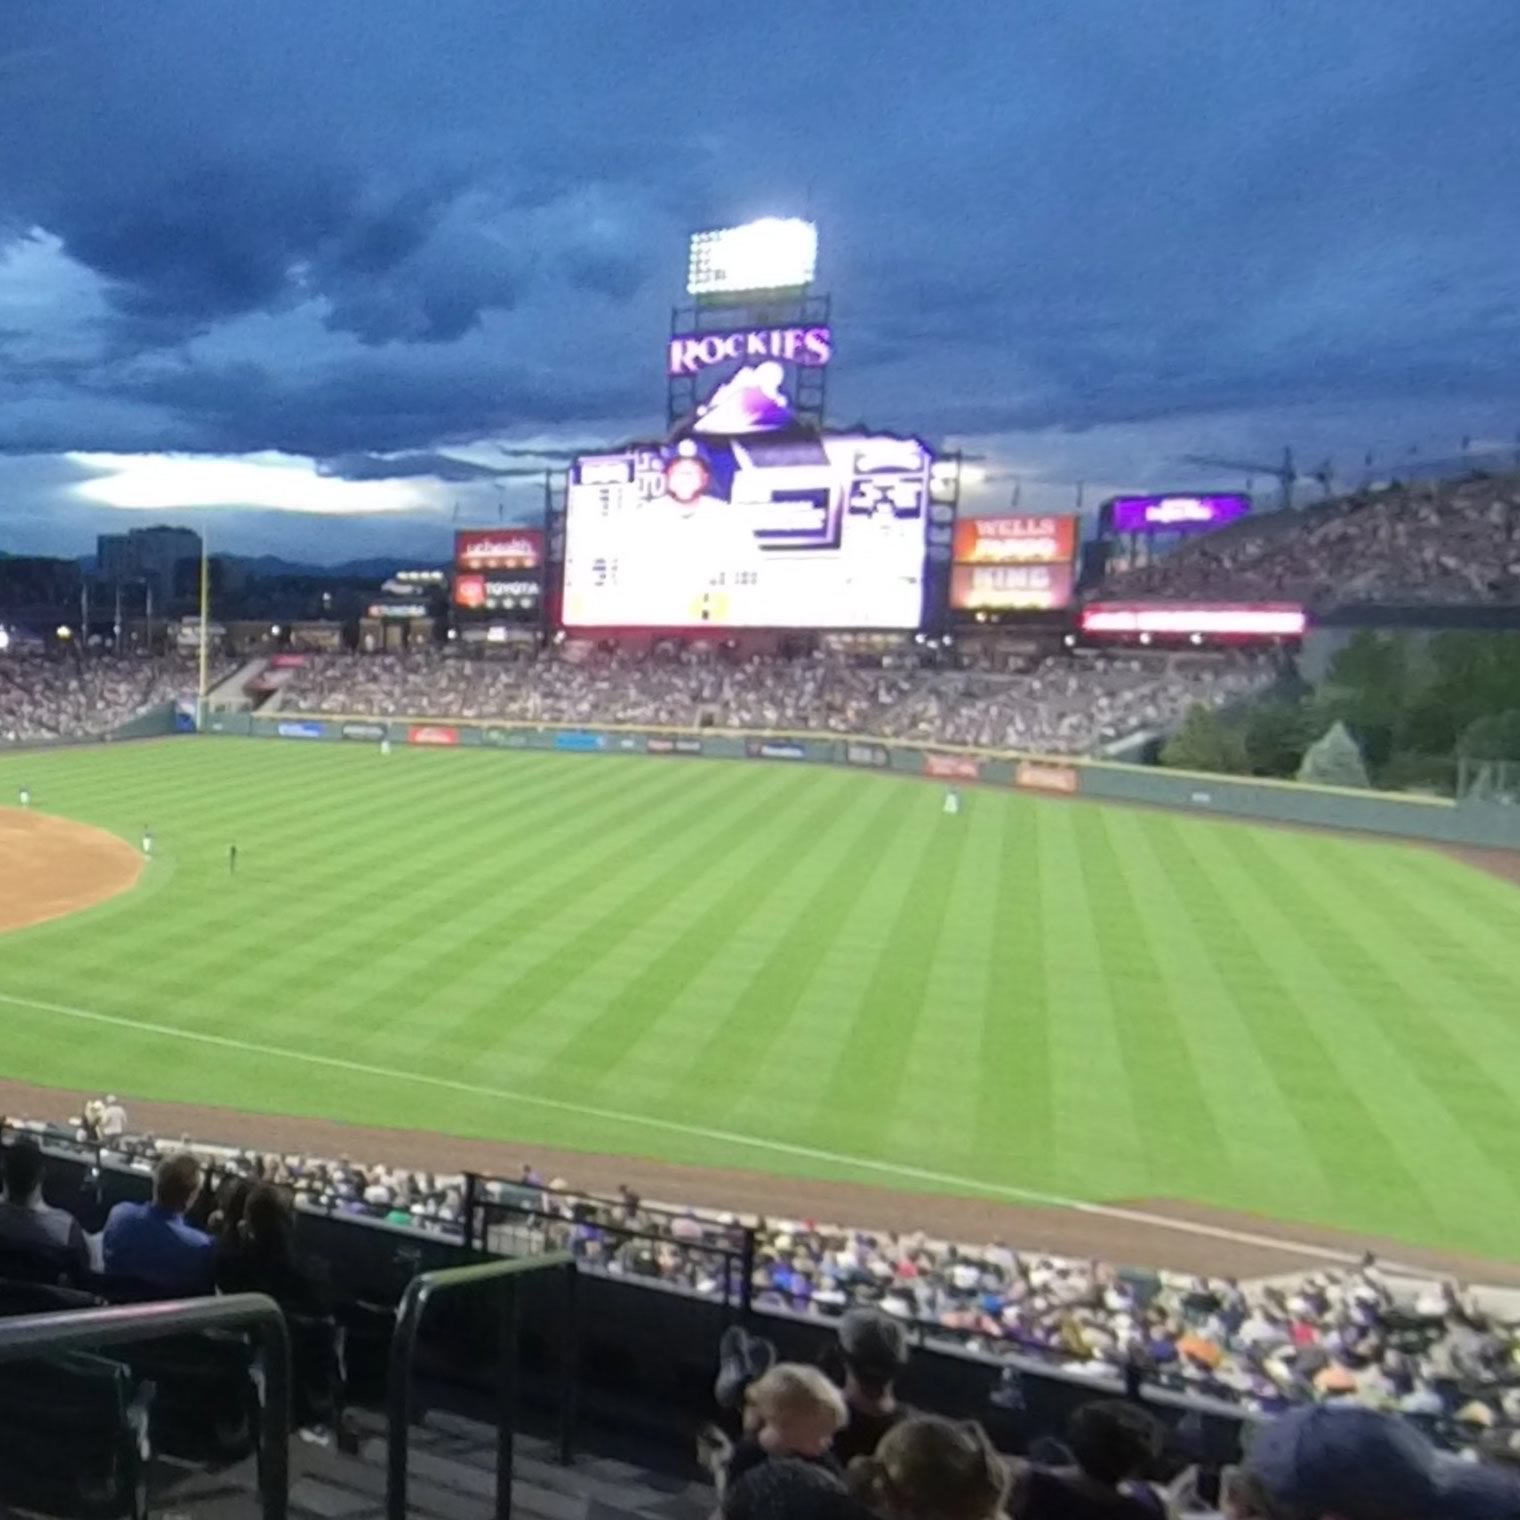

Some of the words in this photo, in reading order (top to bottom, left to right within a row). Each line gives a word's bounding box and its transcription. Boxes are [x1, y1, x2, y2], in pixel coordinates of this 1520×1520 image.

[670, 328, 830, 373] ROCKIES
[975, 518, 1055, 536] WELLS
[484, 581, 540, 596] TOYOTA
